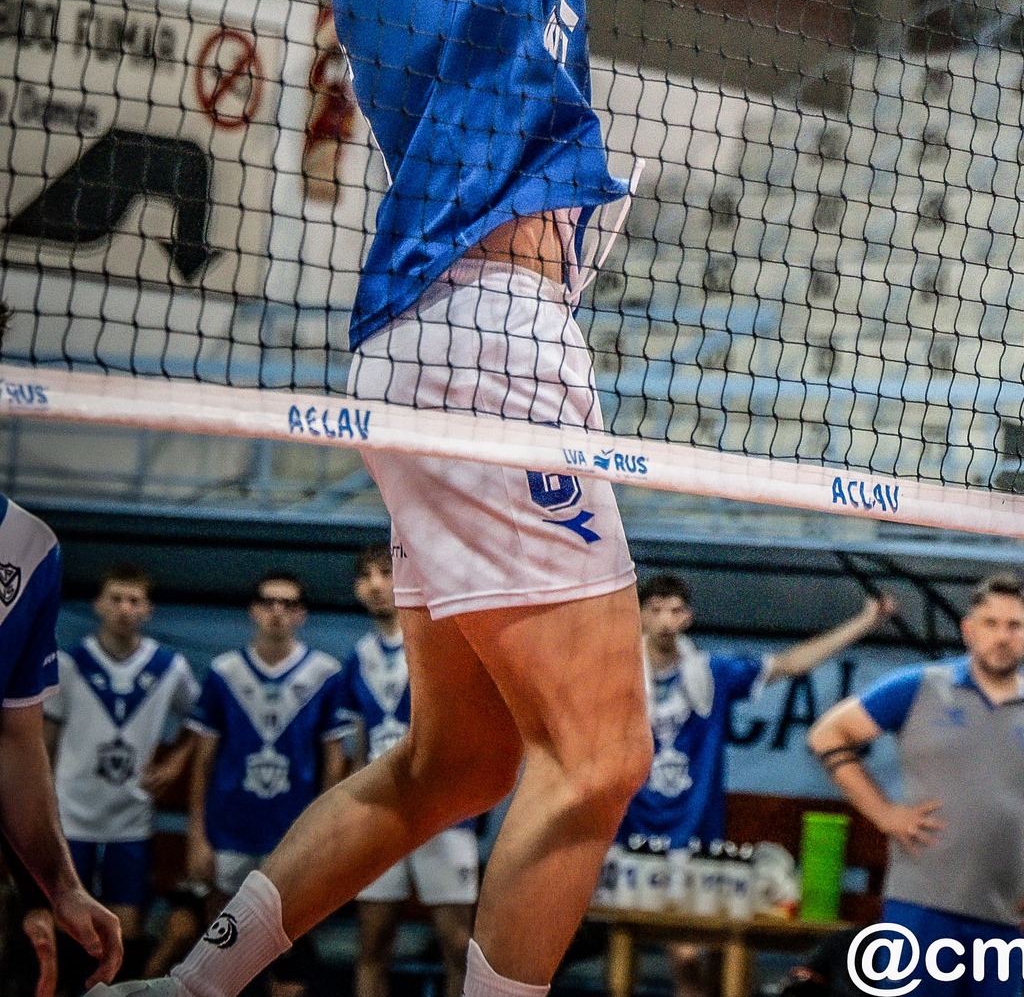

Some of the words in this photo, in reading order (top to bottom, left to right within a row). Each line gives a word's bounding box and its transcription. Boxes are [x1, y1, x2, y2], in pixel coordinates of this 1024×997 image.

[563, 448, 587, 466] LVA
[614, 453, 648, 475] RUS
[832, 476, 899, 513] ACLAV
